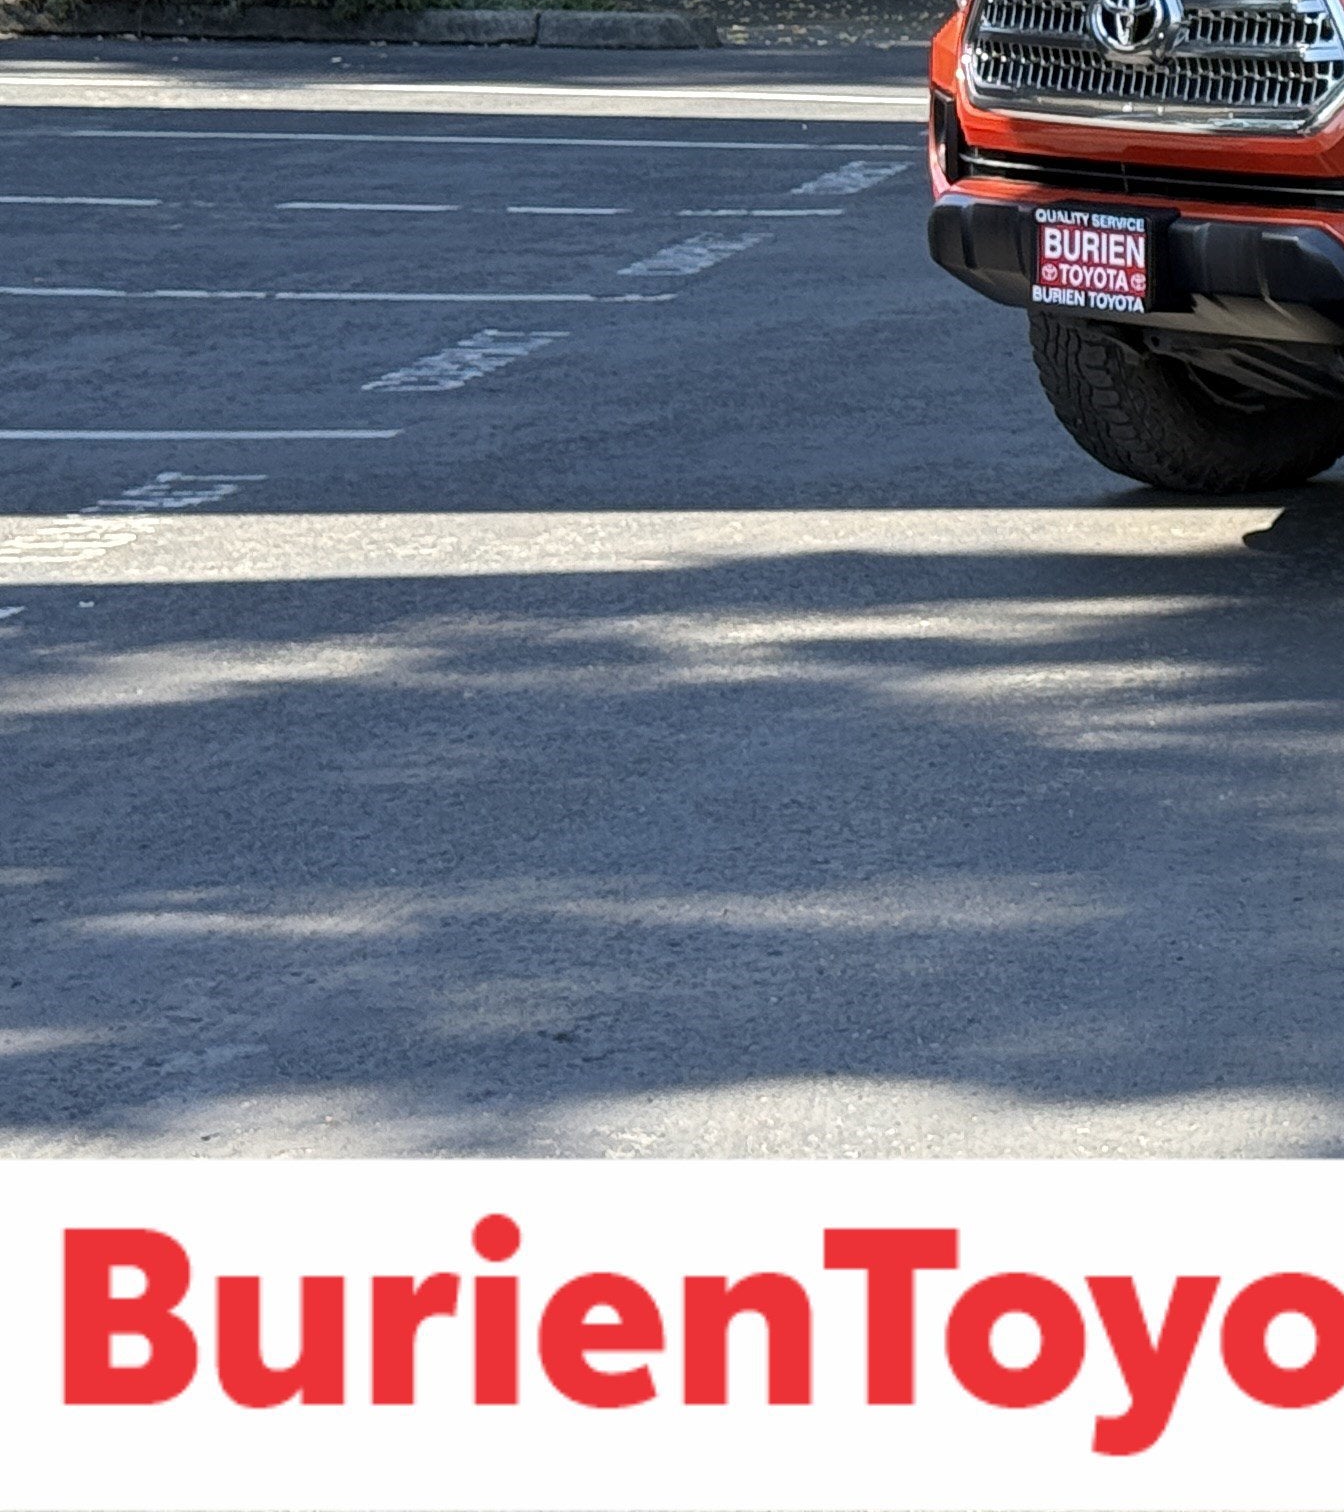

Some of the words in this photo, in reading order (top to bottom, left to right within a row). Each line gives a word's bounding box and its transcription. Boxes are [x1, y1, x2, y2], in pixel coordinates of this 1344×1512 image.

[1035, 208, 1090, 227] QUALITY
[1091, 213, 1145, 232] SERVICE
[1044, 227, 1145, 268] BURIEN
[1058, 263, 1130, 292] TOYOTA
[1032, 284, 1086, 307] BURIEN
[1087, 291, 1145, 314] TOYOTA
